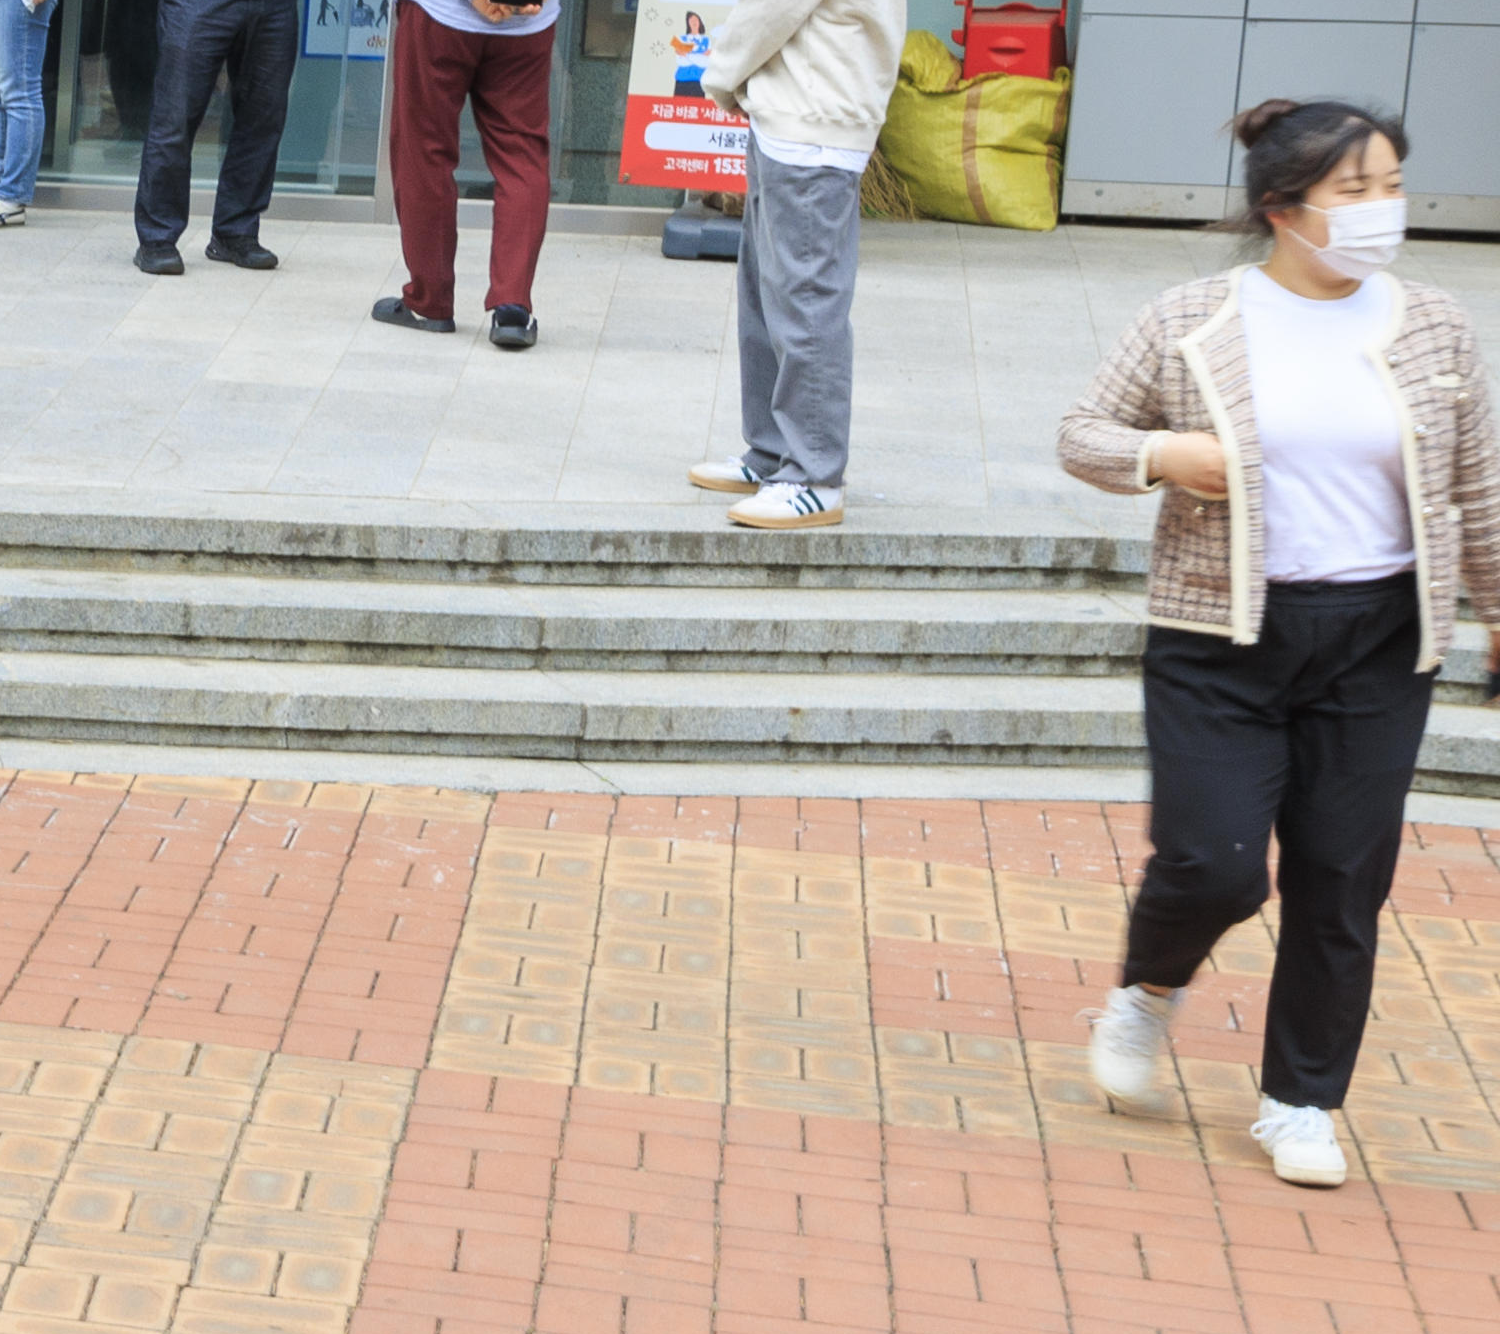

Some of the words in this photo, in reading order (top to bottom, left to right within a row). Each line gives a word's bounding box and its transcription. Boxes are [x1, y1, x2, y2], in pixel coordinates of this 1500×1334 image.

[652, 104, 675, 119] 지금
[675, 106, 699, 119] 바로
[663, 156, 709, 174] 고객센터
